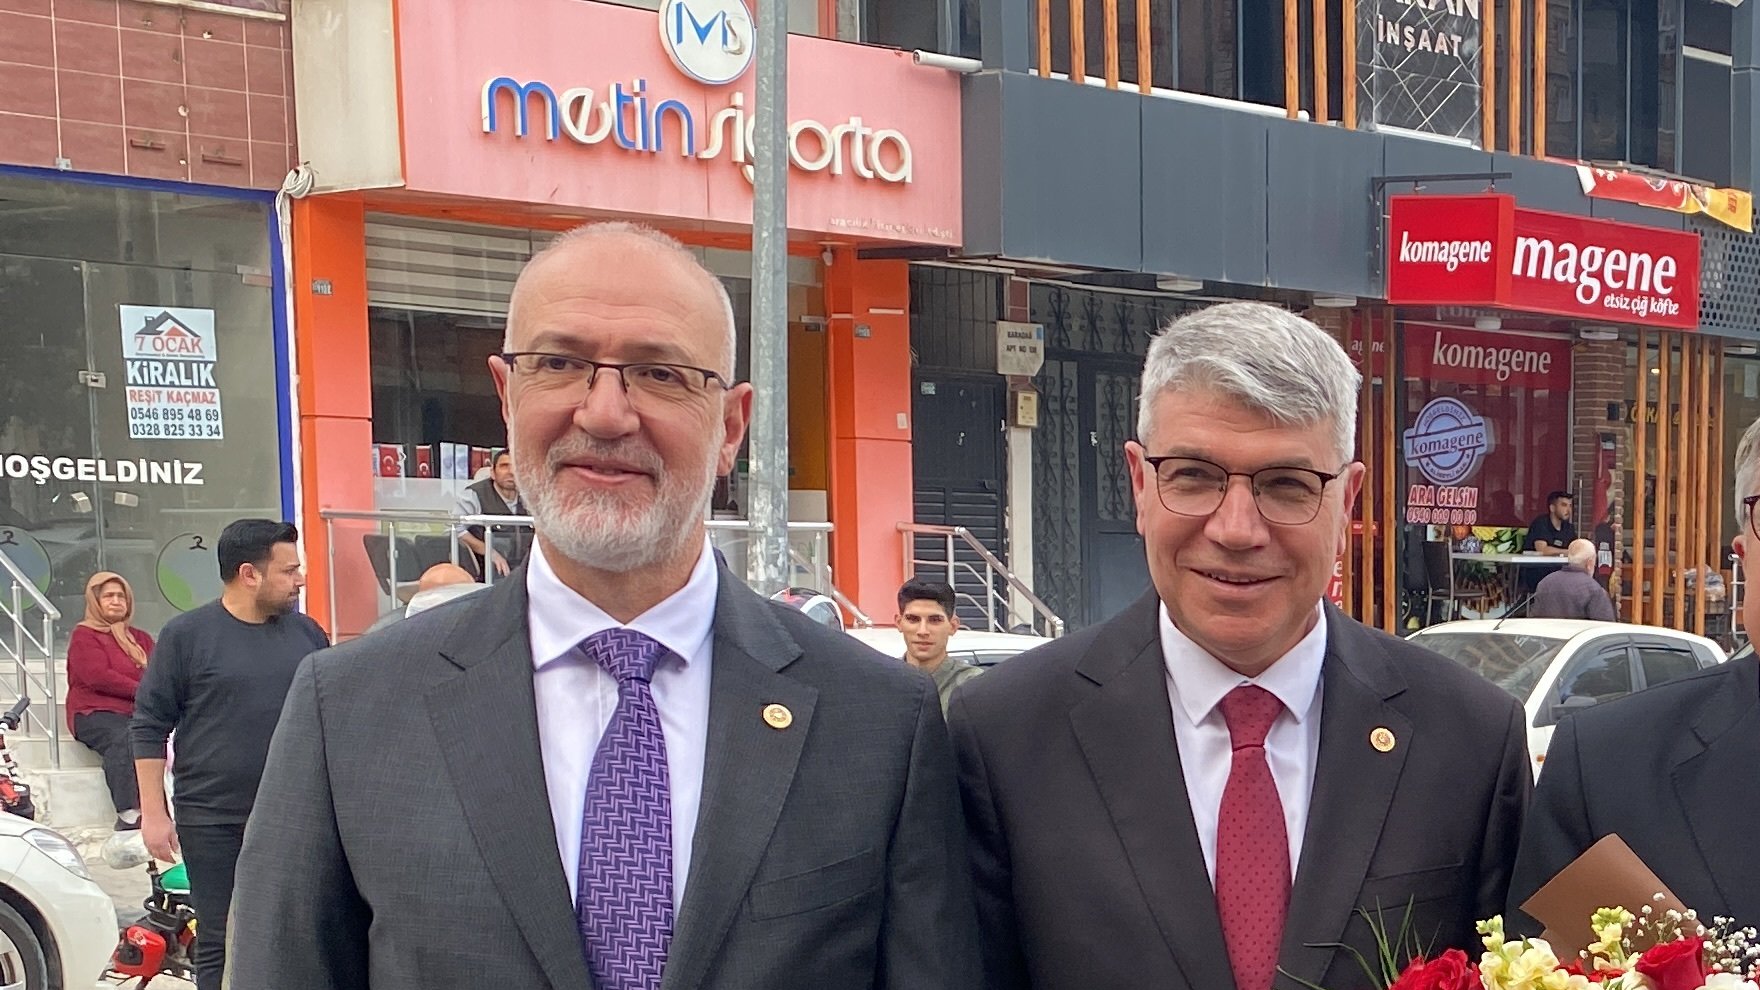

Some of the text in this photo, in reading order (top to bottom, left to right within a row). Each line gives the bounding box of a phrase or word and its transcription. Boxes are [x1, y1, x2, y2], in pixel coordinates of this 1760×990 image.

[1378, 14, 1462, 57] İNŞAAT
[697, 91, 913, 186] siorta
[1399, 231, 1491, 272] komagene
[1604, 293, 1679, 317] etsiz çiğ köfte
[152, 336, 203, 353] OCAK
[1432, 331, 1552, 382] komagene
[166, 391, 216, 407] KAÇMAZ
[130, 408, 219, 421] 0546 895 48 69
[132, 424, 221, 437] 0328 825 33 34
[1411, 431, 1484, 455] komagene
[1408, 485, 1435, 506] ARA
